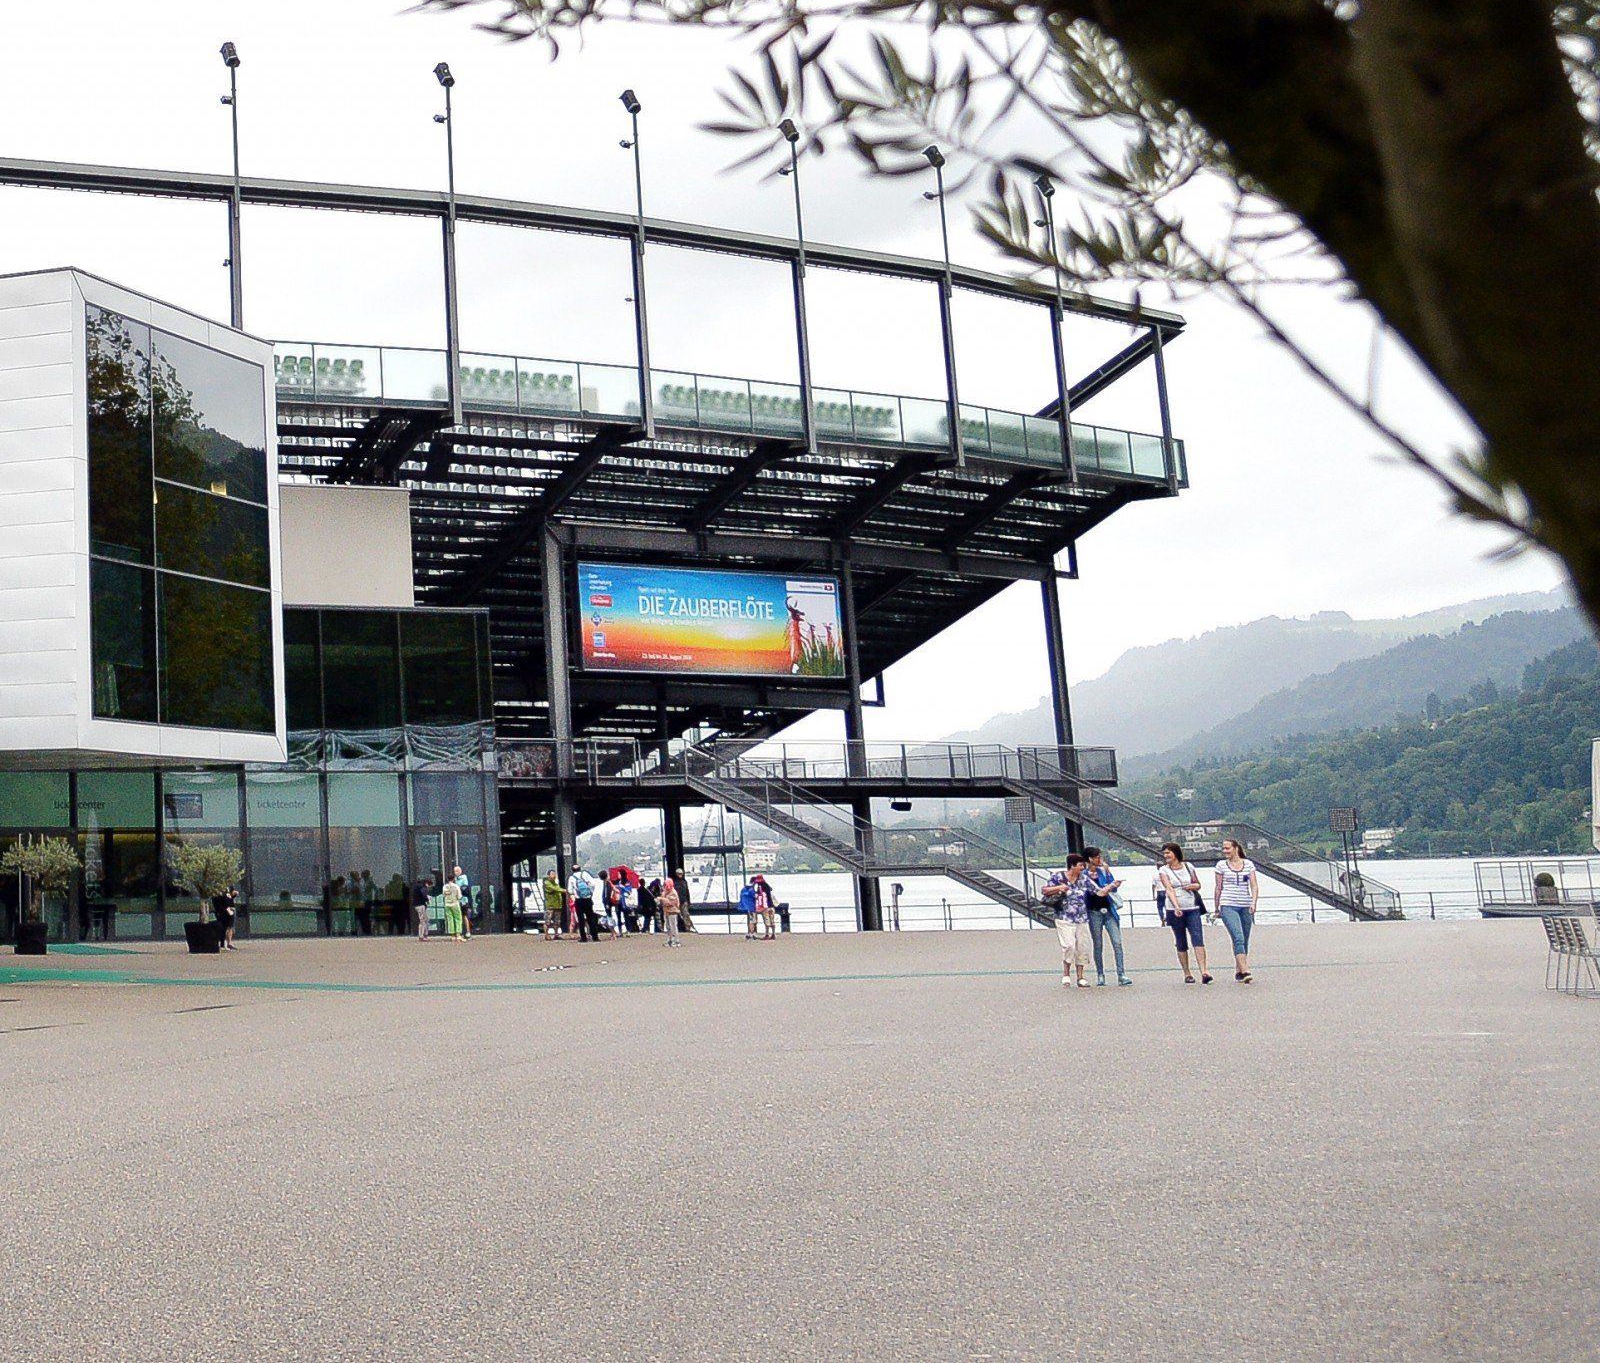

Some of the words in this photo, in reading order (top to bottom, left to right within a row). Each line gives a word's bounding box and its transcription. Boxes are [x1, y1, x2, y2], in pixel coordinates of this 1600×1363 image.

[638, 595, 665, 616] DIE
[668, 595, 775, 620] ZAUBERFLÖTE
[53, 800, 105, 809] tickcenter
